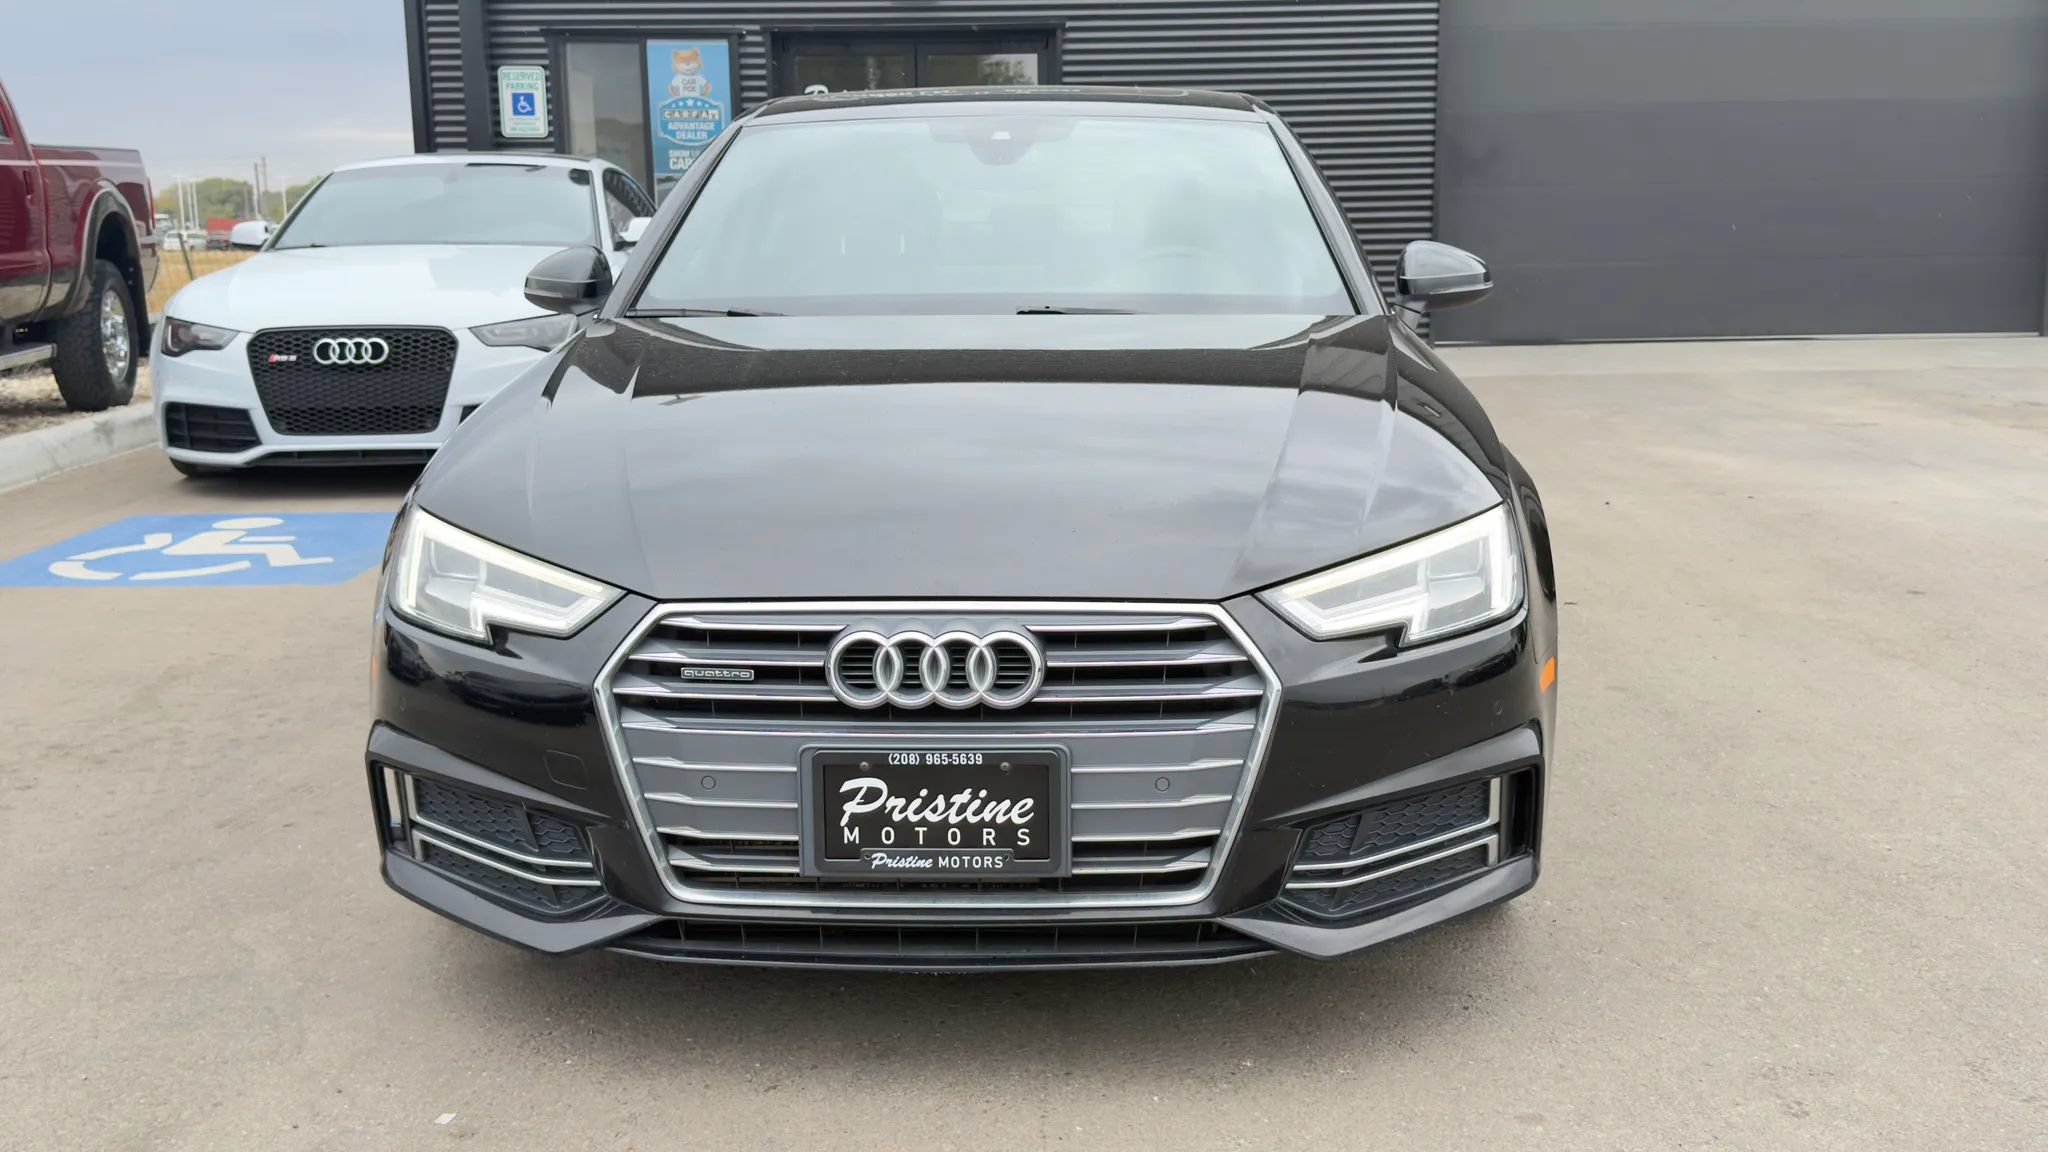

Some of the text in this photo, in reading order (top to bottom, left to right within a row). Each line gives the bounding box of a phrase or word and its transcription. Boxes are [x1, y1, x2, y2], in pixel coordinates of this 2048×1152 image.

[502, 72, 541, 81] RESERVED
[505, 82, 540, 91] PARKING
[681, 78, 697, 86] CAR
[664, 110, 719, 120] CARFAX
[668, 121, 714, 131] ADVANTAGE
[676, 131, 708, 140] DEALER
[669, 158, 696, 170] CAR
[684, 670, 750, 678] quattro
[888, 753, 983, 765] (208) 965-5639
[839, 777, 1034, 827] Pristine
[843, 826, 1030, 846] MOTORS
[871, 852, 1003, 869] Pristine MOTORS
